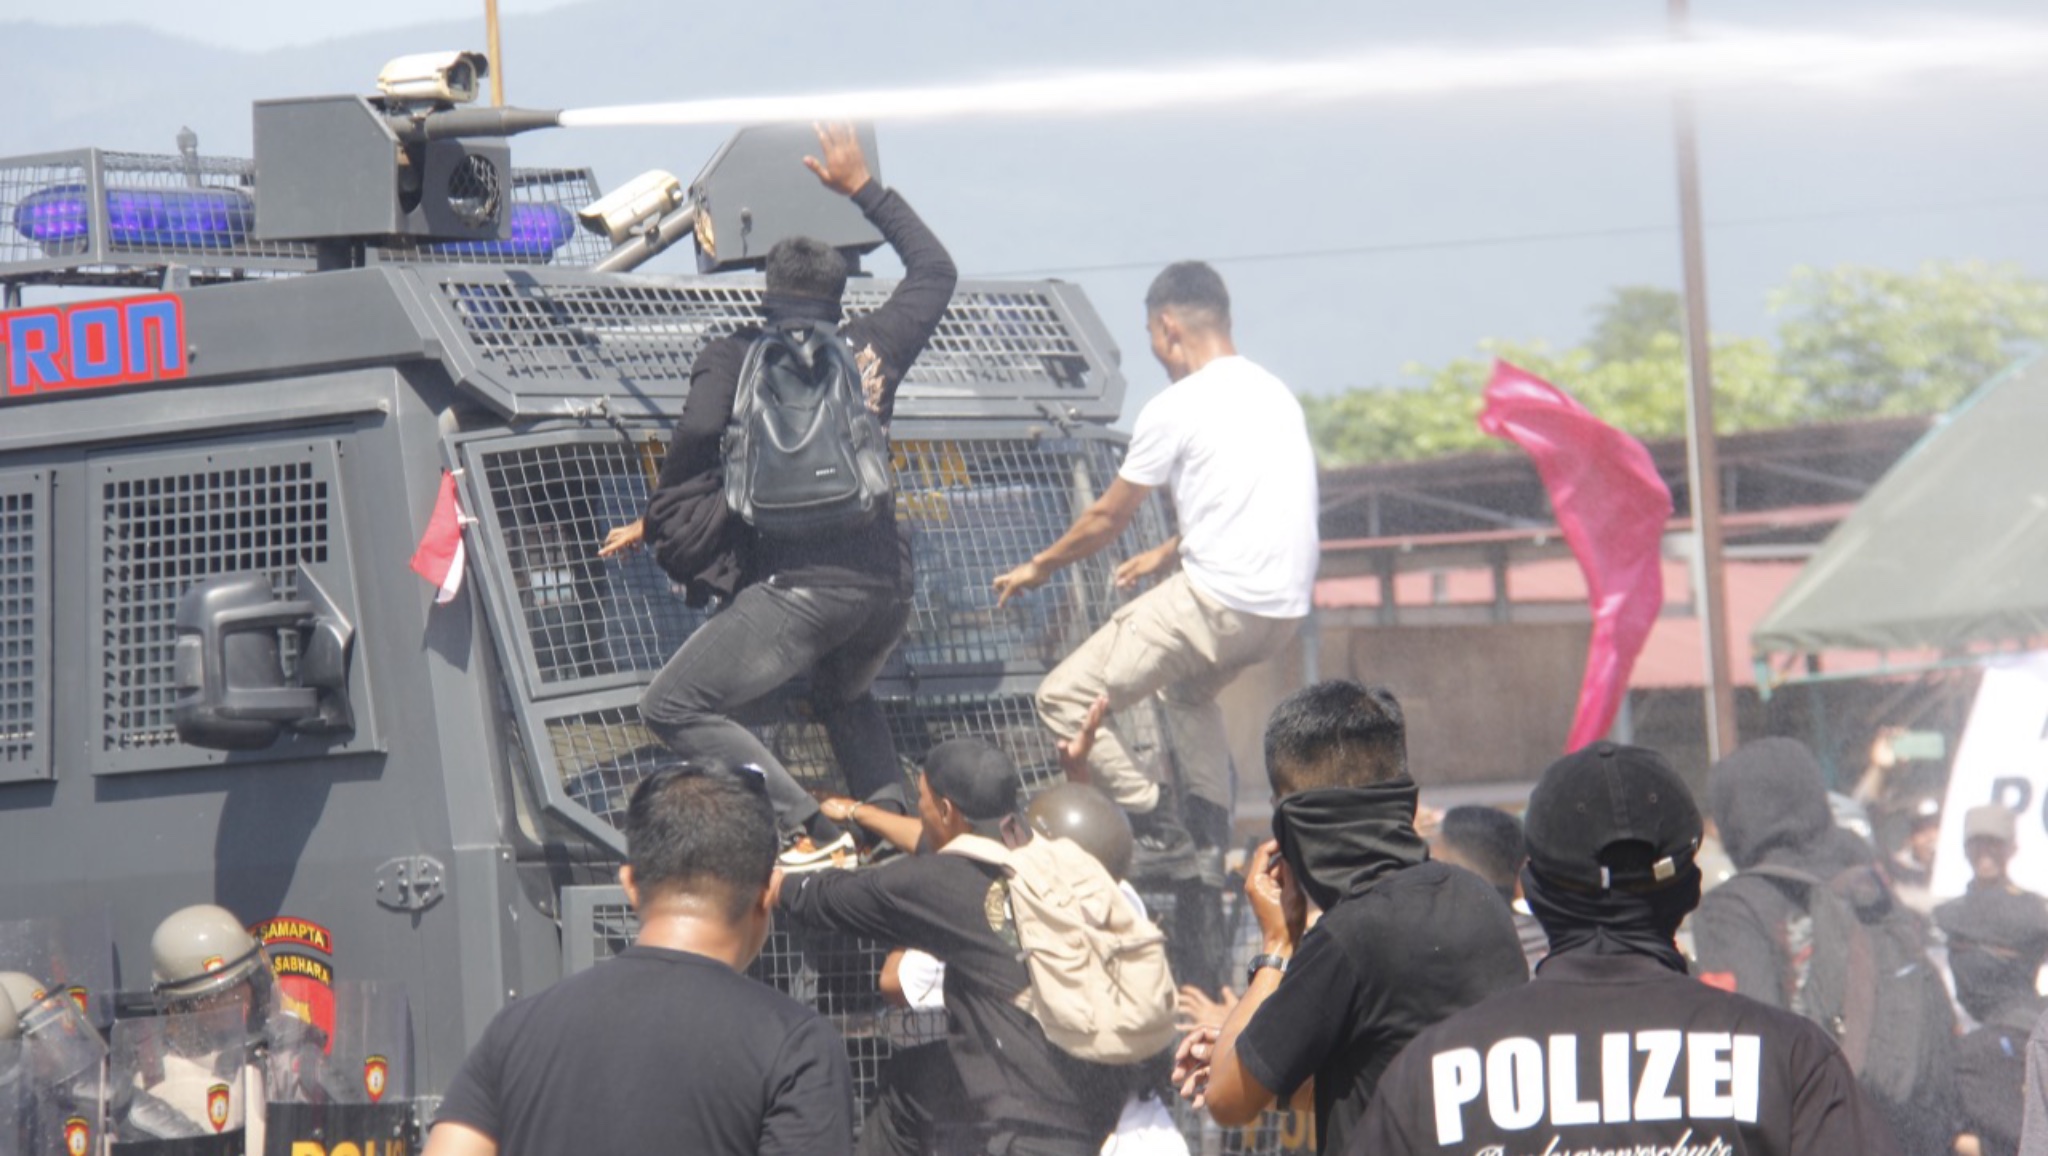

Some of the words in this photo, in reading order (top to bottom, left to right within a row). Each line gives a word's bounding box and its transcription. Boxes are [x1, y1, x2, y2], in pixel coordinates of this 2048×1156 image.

[0, 294, 185, 391] RON
[260, 920, 325, 947] SAMAPTA
[274, 955, 331, 986] SABHARA
[1432, 1029, 1761, 1146] POLIZEI
